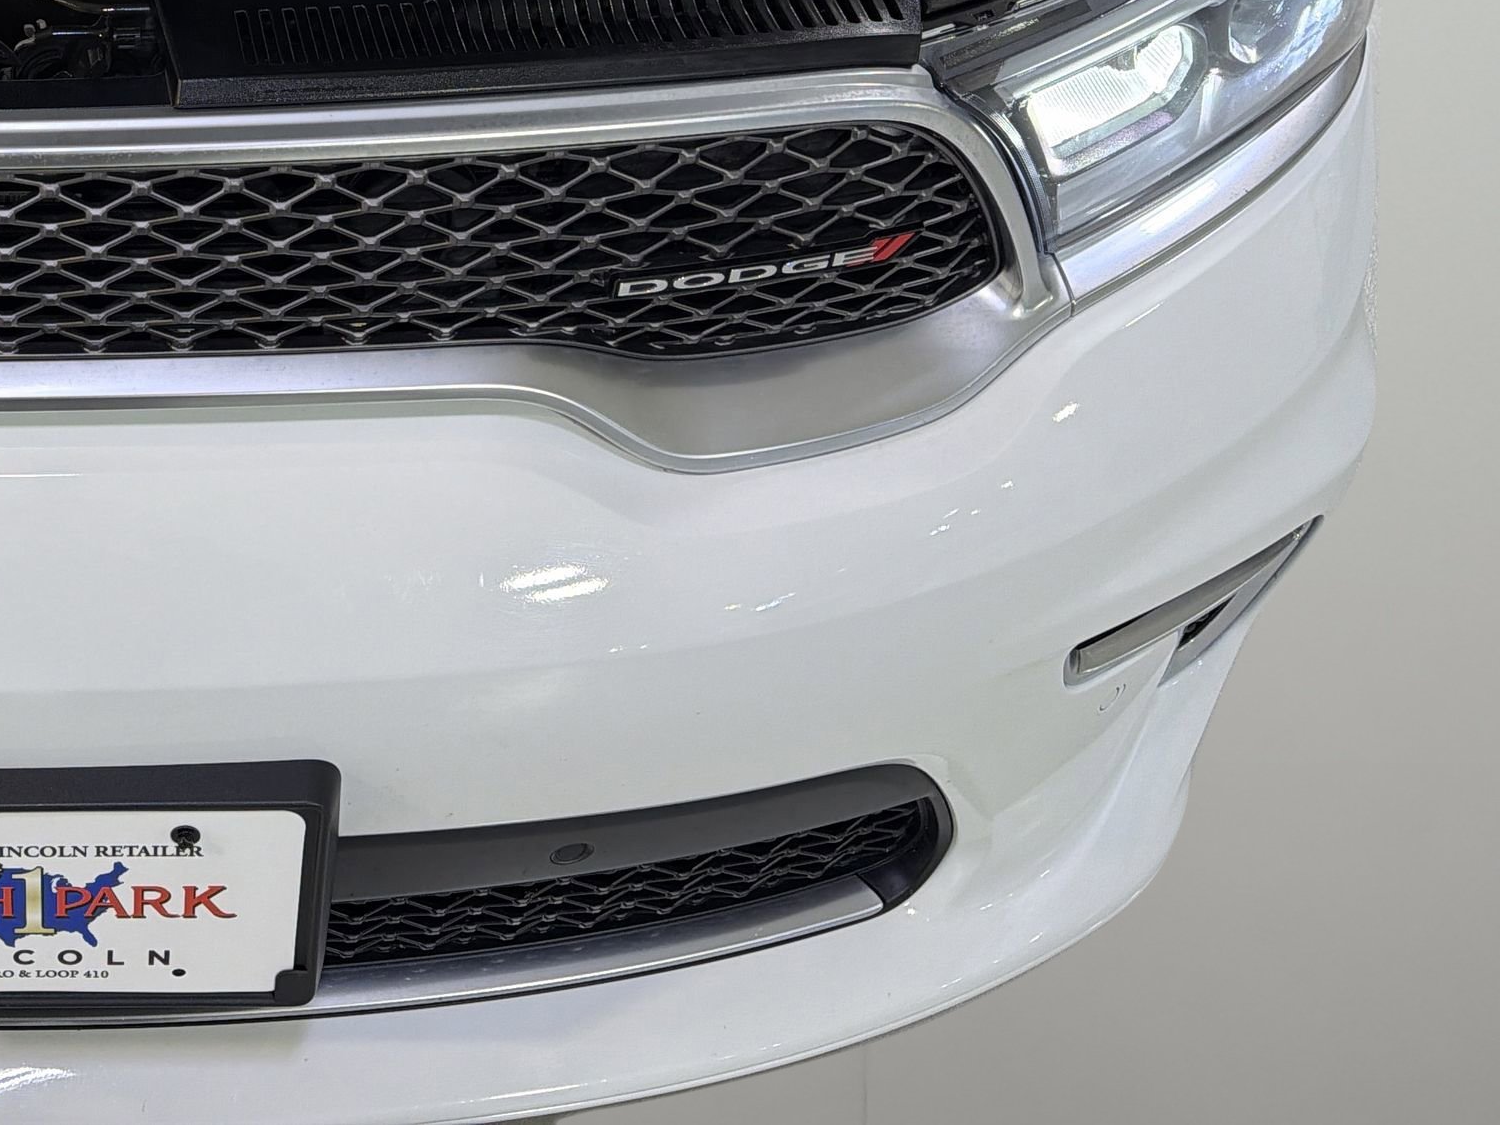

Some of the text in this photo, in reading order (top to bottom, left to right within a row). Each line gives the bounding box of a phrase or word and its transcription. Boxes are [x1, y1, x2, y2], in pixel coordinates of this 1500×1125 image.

[617, 245, 879, 298] DODGE
[94, 845, 204, 857] RETAILER
[54, 886, 239, 921] PARK
[19, 970, 32, 978] &
[36, 970, 80, 978] LOOP
[83, 970, 109, 979] 410
